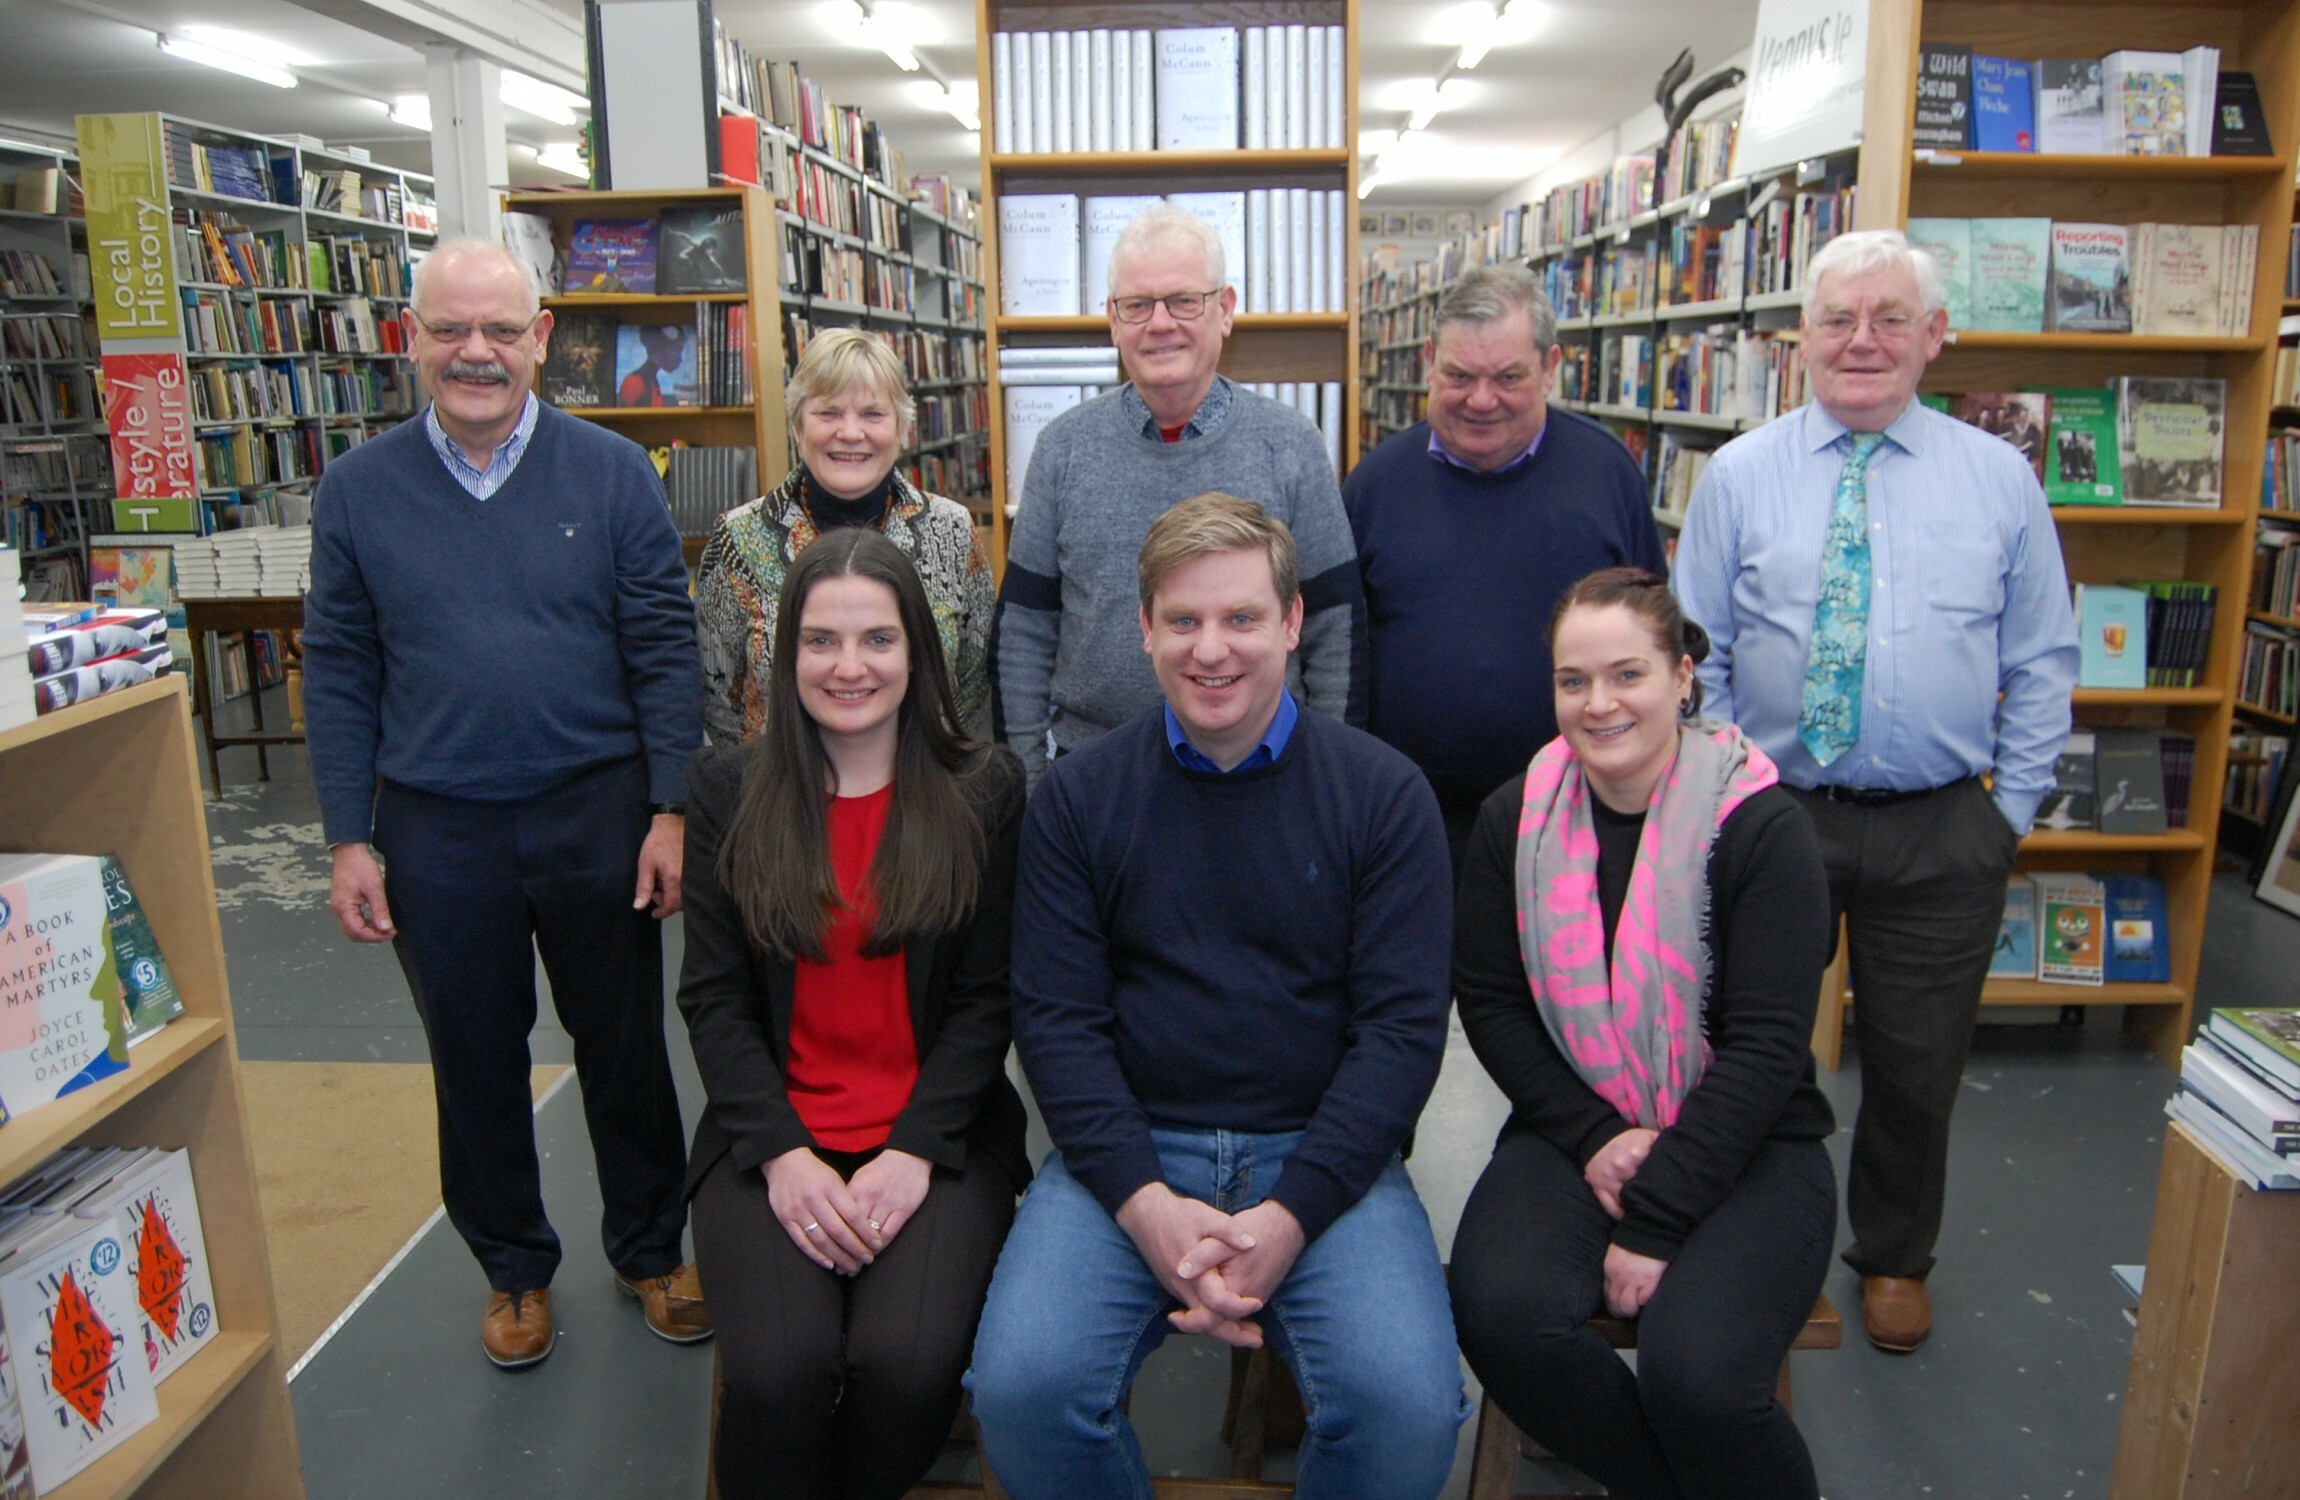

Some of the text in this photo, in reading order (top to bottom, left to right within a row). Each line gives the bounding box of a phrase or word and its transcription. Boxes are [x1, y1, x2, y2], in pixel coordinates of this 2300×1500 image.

[1166, 42, 1207, 54] Colum
[1162, 57, 1211, 69] McCann
[1929, 52, 1967, 76] Wild
[1917, 77, 1957, 98] Swan
[1006, 208, 1047, 220] Colum
[1093, 209, 1132, 220] Colum
[1002, 223, 1051, 234] McCann
[1089, 223, 1122, 234] McCa
[2055, 228, 2125, 246] Reporting
[2062, 243, 2121, 257] Troubles
[136, 197, 168, 327] History
[100, 239, 138, 328] Local
[554, 394, 599, 405] BONNER
[566, 385, 586, 395] Paul
[1015, 399, 1053, 410] Colum
[118, 405, 163, 499] style
[6, 910, 75, 945] A BOOK
[35, 937, 53, 957] of
[0, 946, 93, 990] AMERICAN
[6, 967, 92, 1009] MARTYRS
[30, 1011, 85, 1043] JOYCE
[30, 1029, 89, 1063] CAROL
[35, 1049, 91, 1082] OATES
